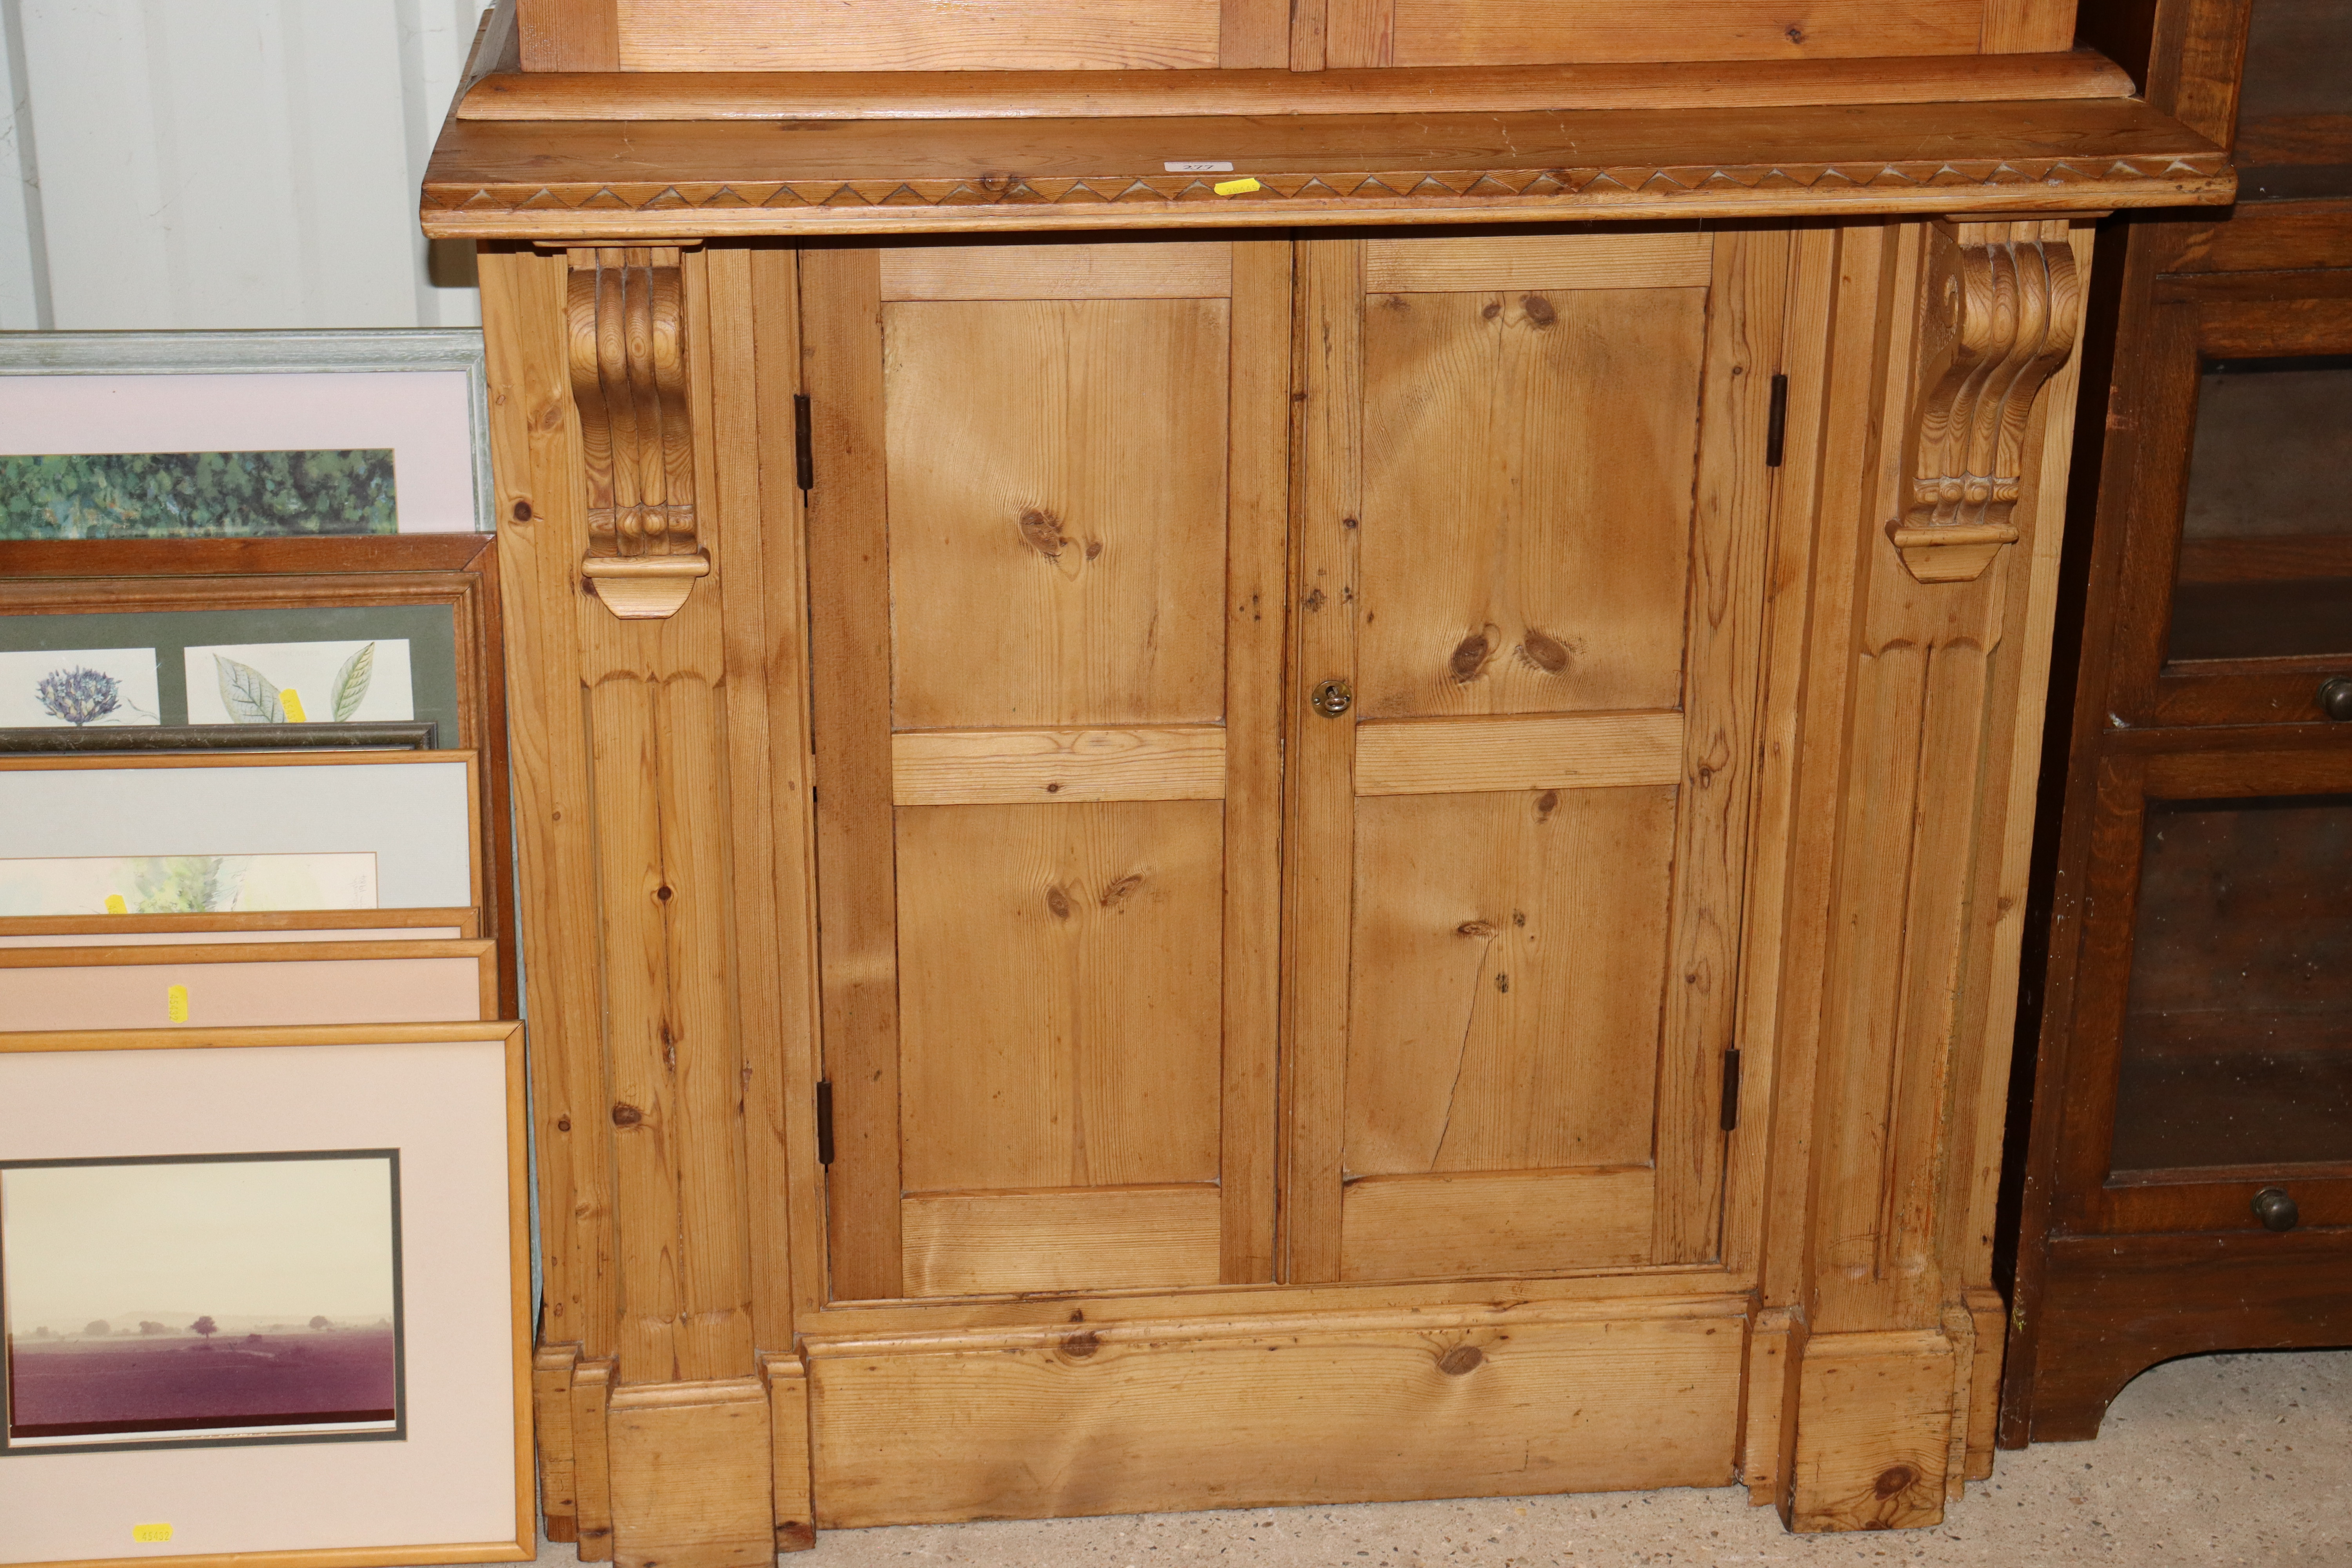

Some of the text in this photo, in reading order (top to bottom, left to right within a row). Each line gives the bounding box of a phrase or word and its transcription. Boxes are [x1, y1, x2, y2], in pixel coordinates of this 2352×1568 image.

[1227, 184, 1258, 194] 20445
[169, 994, 178, 1020] 45432
[142, 1531, 169, 1541] 45432
